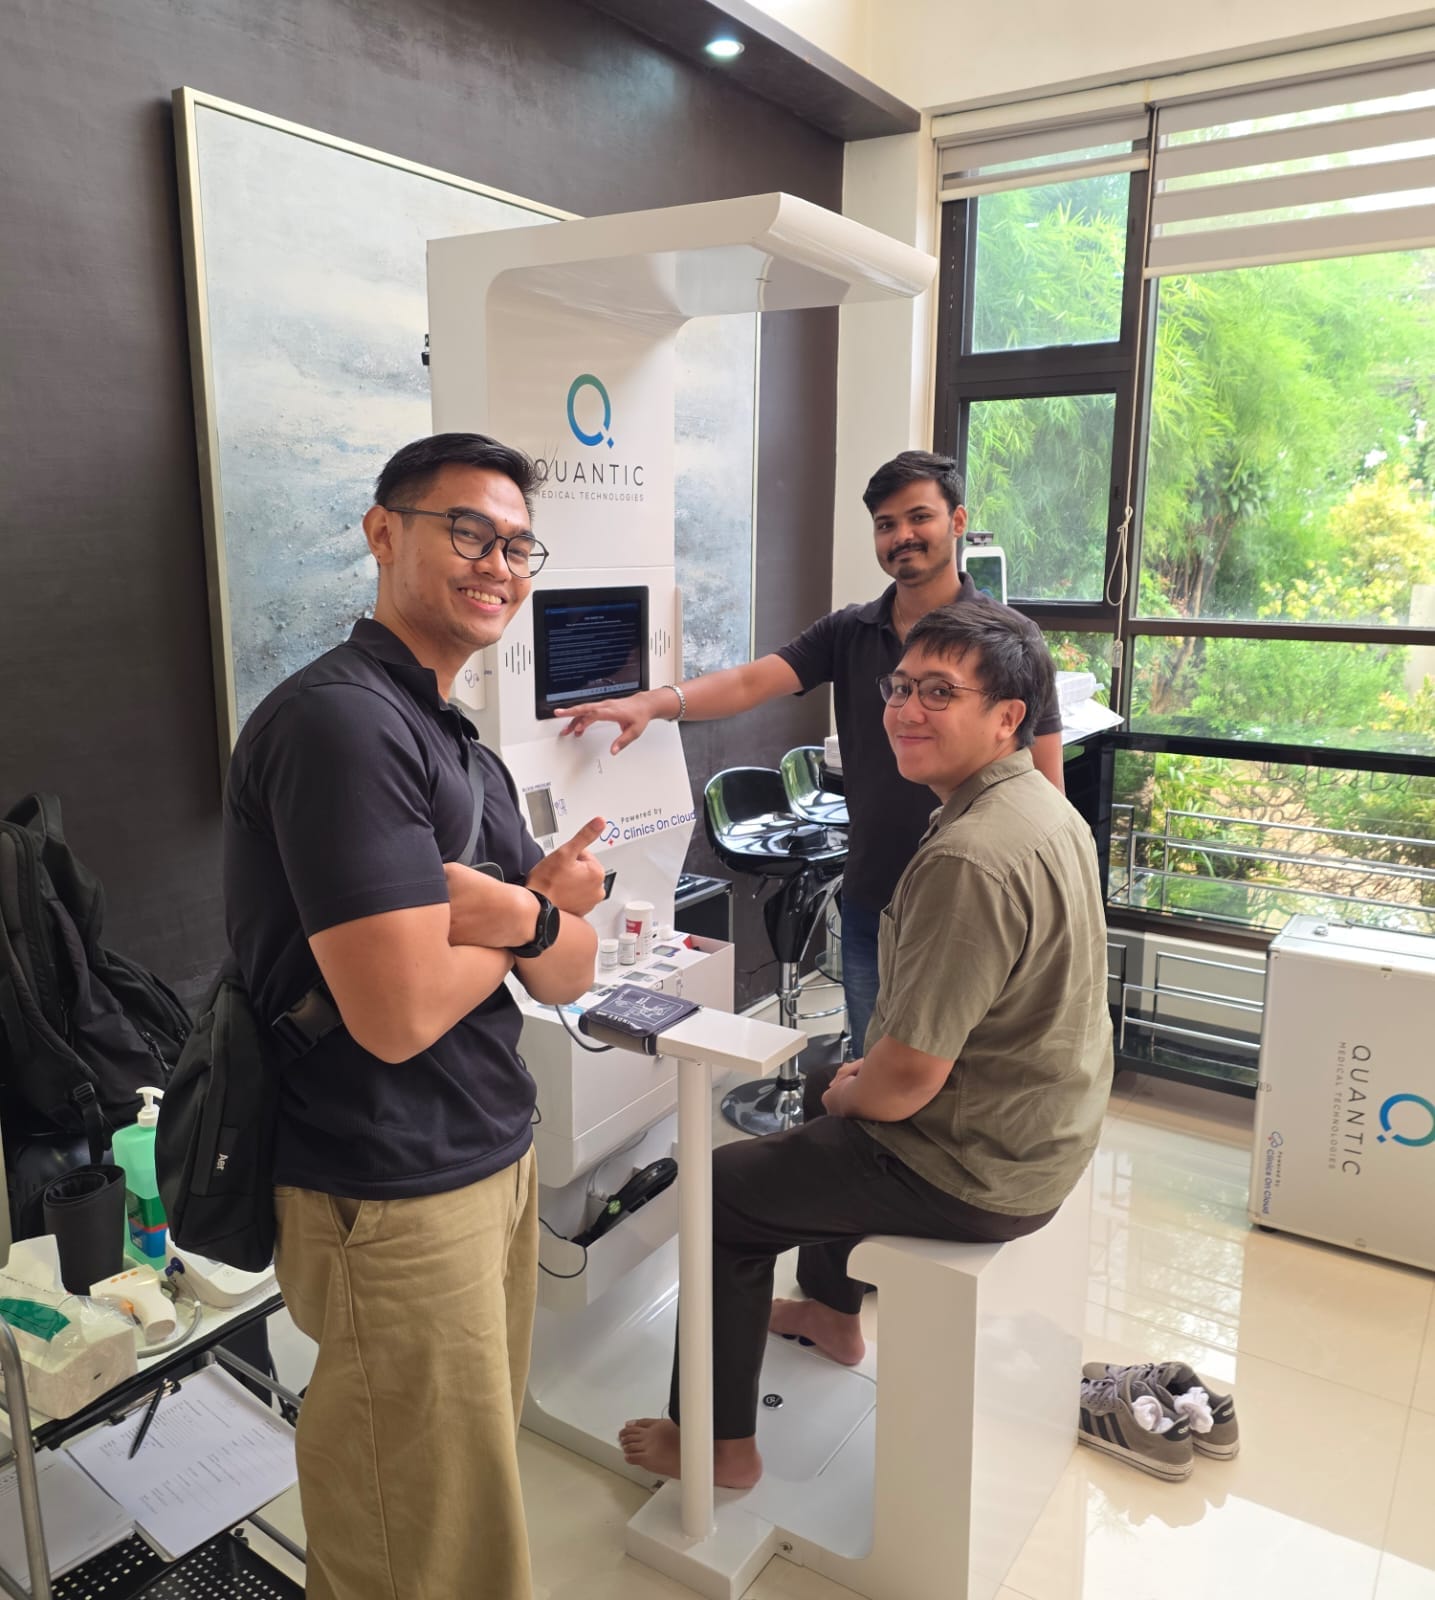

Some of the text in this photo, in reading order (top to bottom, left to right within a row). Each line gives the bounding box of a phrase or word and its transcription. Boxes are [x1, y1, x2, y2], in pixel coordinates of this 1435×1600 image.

[533, 458, 644, 486] QUANTIC
[579, 491, 644, 502] TECHNOLOGIES
[620, 809, 652, 824] Powered
[623, 811, 697, 840] Clinics On Cloud
[1328, 1041, 1347, 1170] MEDICAL TECHNOLOGIES
[1342, 1044, 1372, 1176] QUANTIC
[1262, 1149, 1275, 1215] Clinics On Cloud
